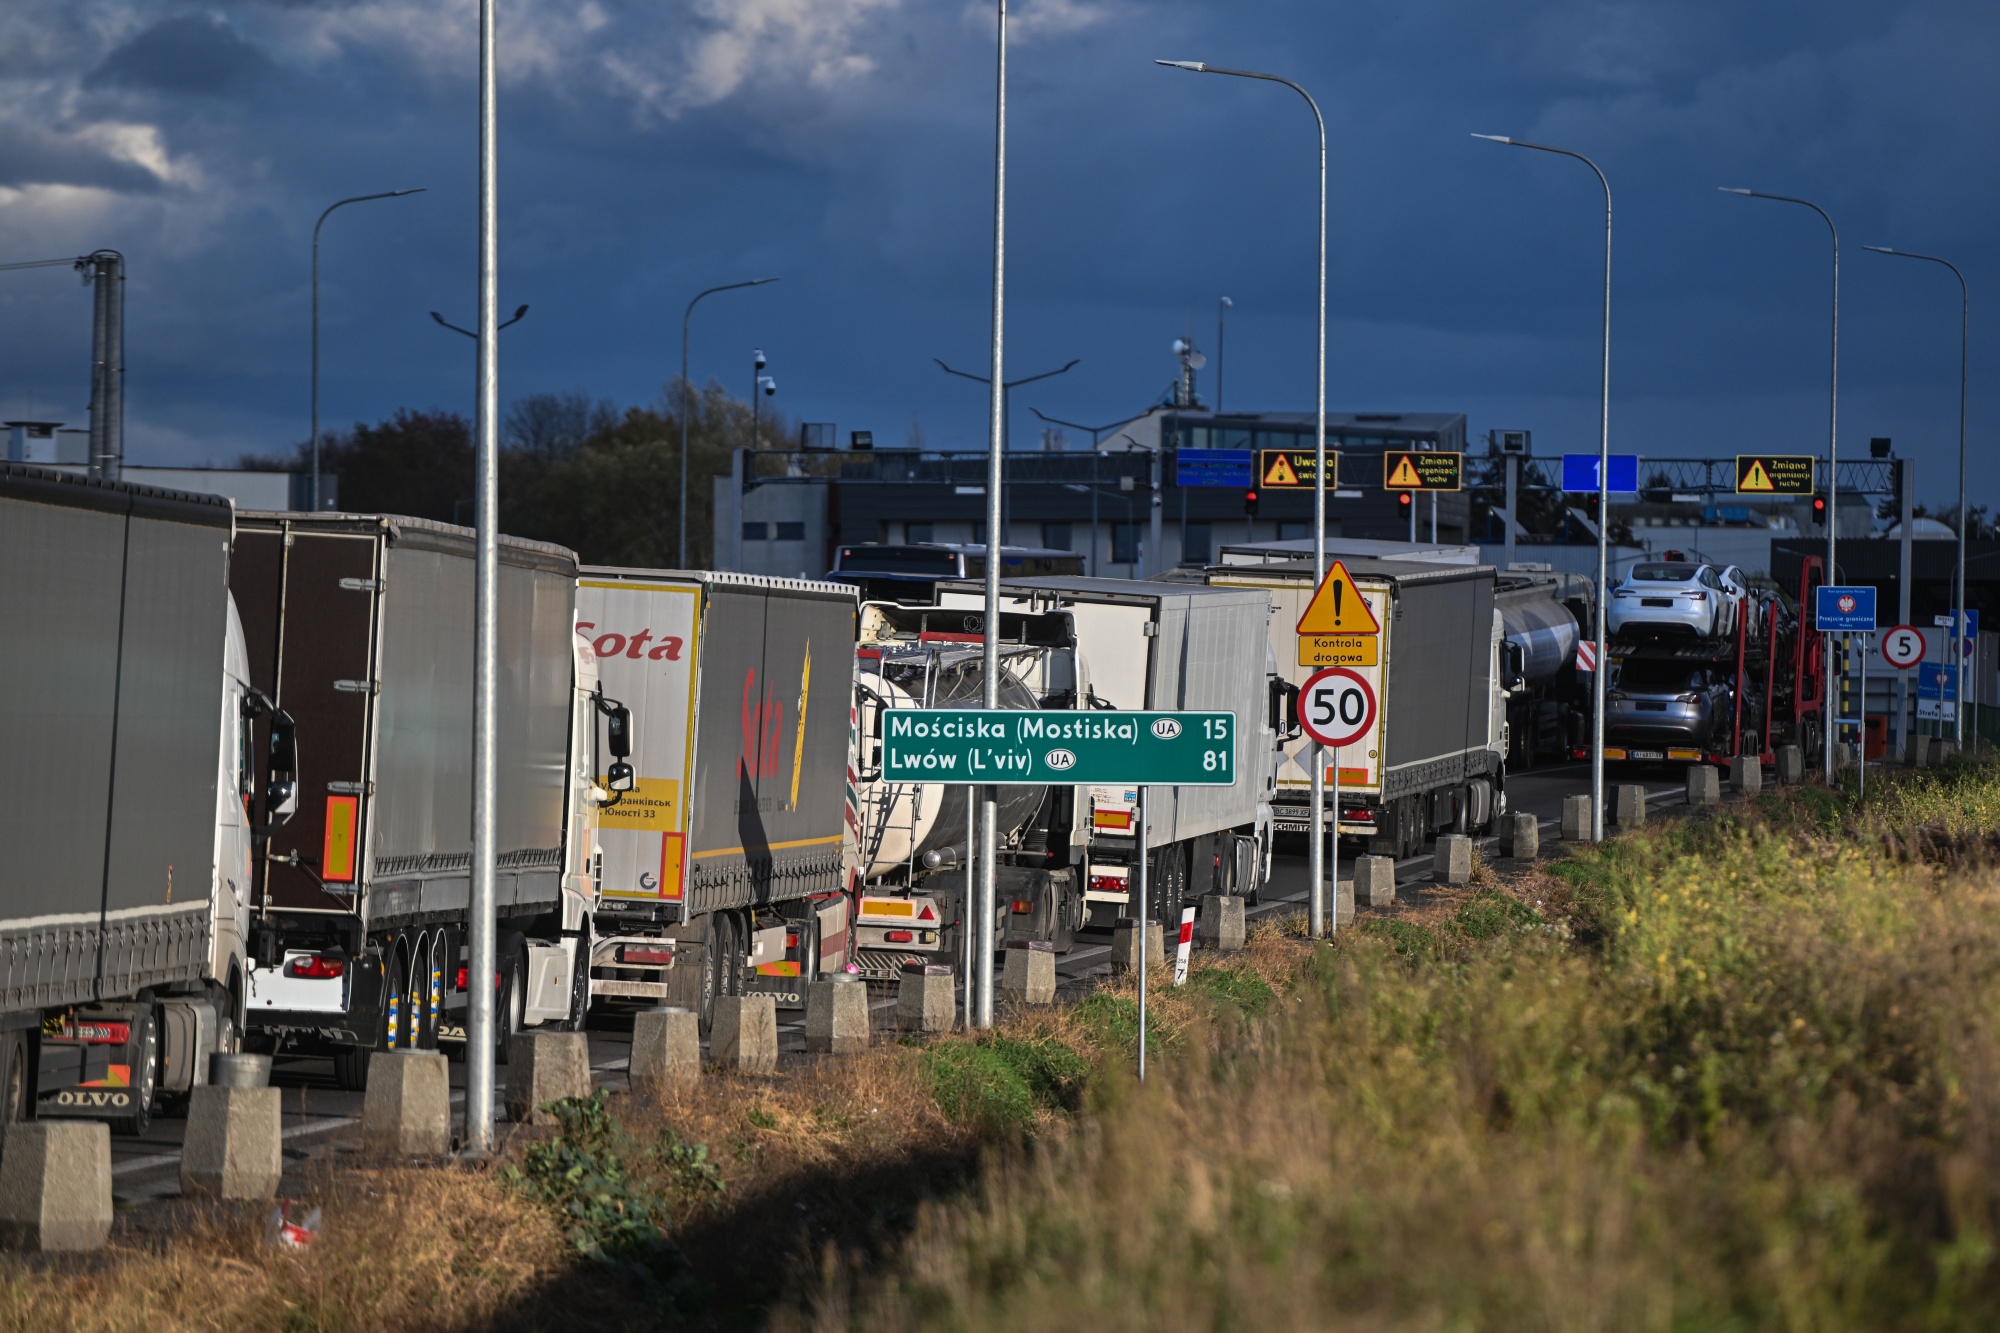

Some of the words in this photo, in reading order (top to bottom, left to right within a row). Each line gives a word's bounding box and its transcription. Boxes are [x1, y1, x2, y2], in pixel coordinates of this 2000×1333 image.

[1294, 456, 1333, 467] Uwaa
[1420, 456, 1454, 466] Zmiana
[1772, 460, 1806, 470] Zmiana
[1417, 467, 1458, 476] organizacji
[1770, 471, 1810, 480] organizacji
[1314, 638, 1362, 648] Kontrola
[1898, 636, 1912, 656] 5
[1314, 653, 1362, 666] drogowa
[1313, 688, 1364, 726] 50
[736, 667, 782, 780] Sota
[891, 716, 1005, 738] Mościska
[1016, 718, 1138, 745] (Mostiska)
[1156, 723, 1176, 736] UA
[1203, 719, 1227, 740] 15
[891, 748, 956, 770] Lwów
[967, 748, 1032, 776] (L'viv)
[1051, 754, 1070, 766] UA
[1203, 750, 1227, 771] 81
[605, 808, 640, 818] Юності
[644, 810, 656, 818] 33
[858, 969, 888, 978] CLE
[1178, 968, 1185, 980] 7
[438, 1026, 466, 1036] DA
[58, 1092, 130, 1107] OLVO
